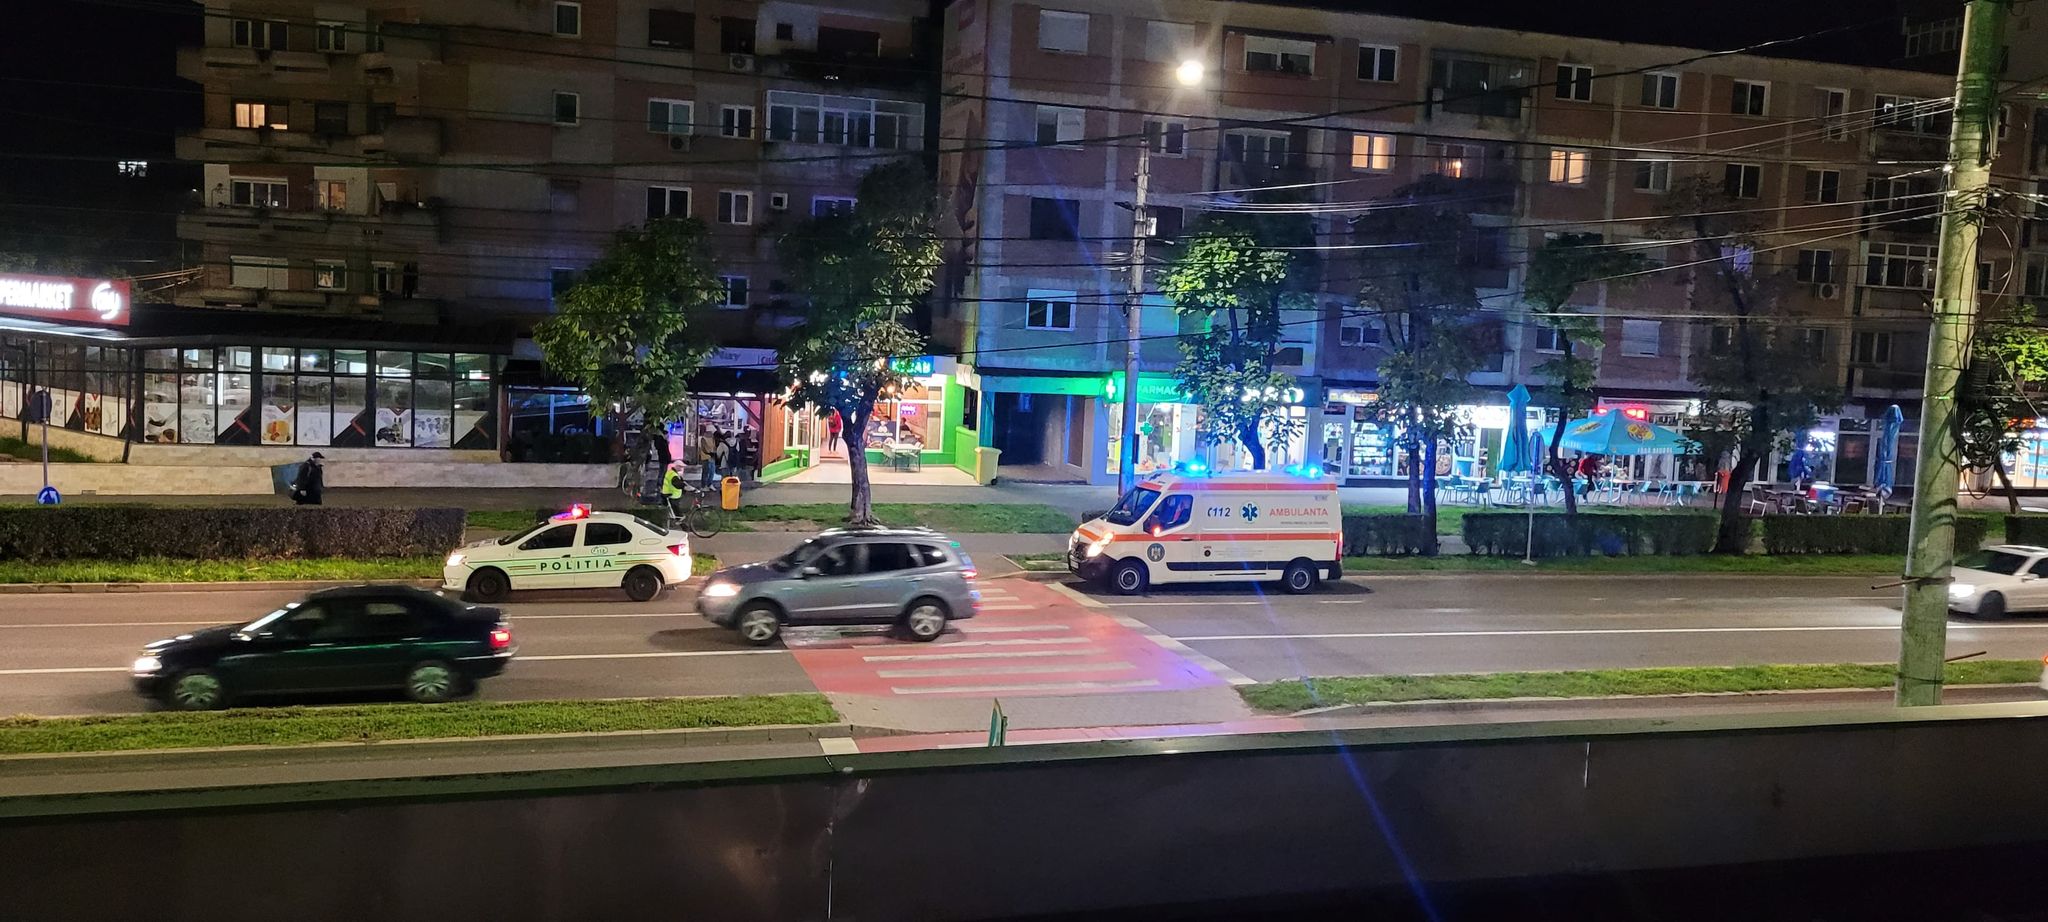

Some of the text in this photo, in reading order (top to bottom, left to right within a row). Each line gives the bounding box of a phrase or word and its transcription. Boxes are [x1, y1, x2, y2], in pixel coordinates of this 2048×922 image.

[1213, 507, 1231, 517] 112
[1269, 507, 1329, 517] AMBULANTA
[540, 559, 612, 571] POLITIA
